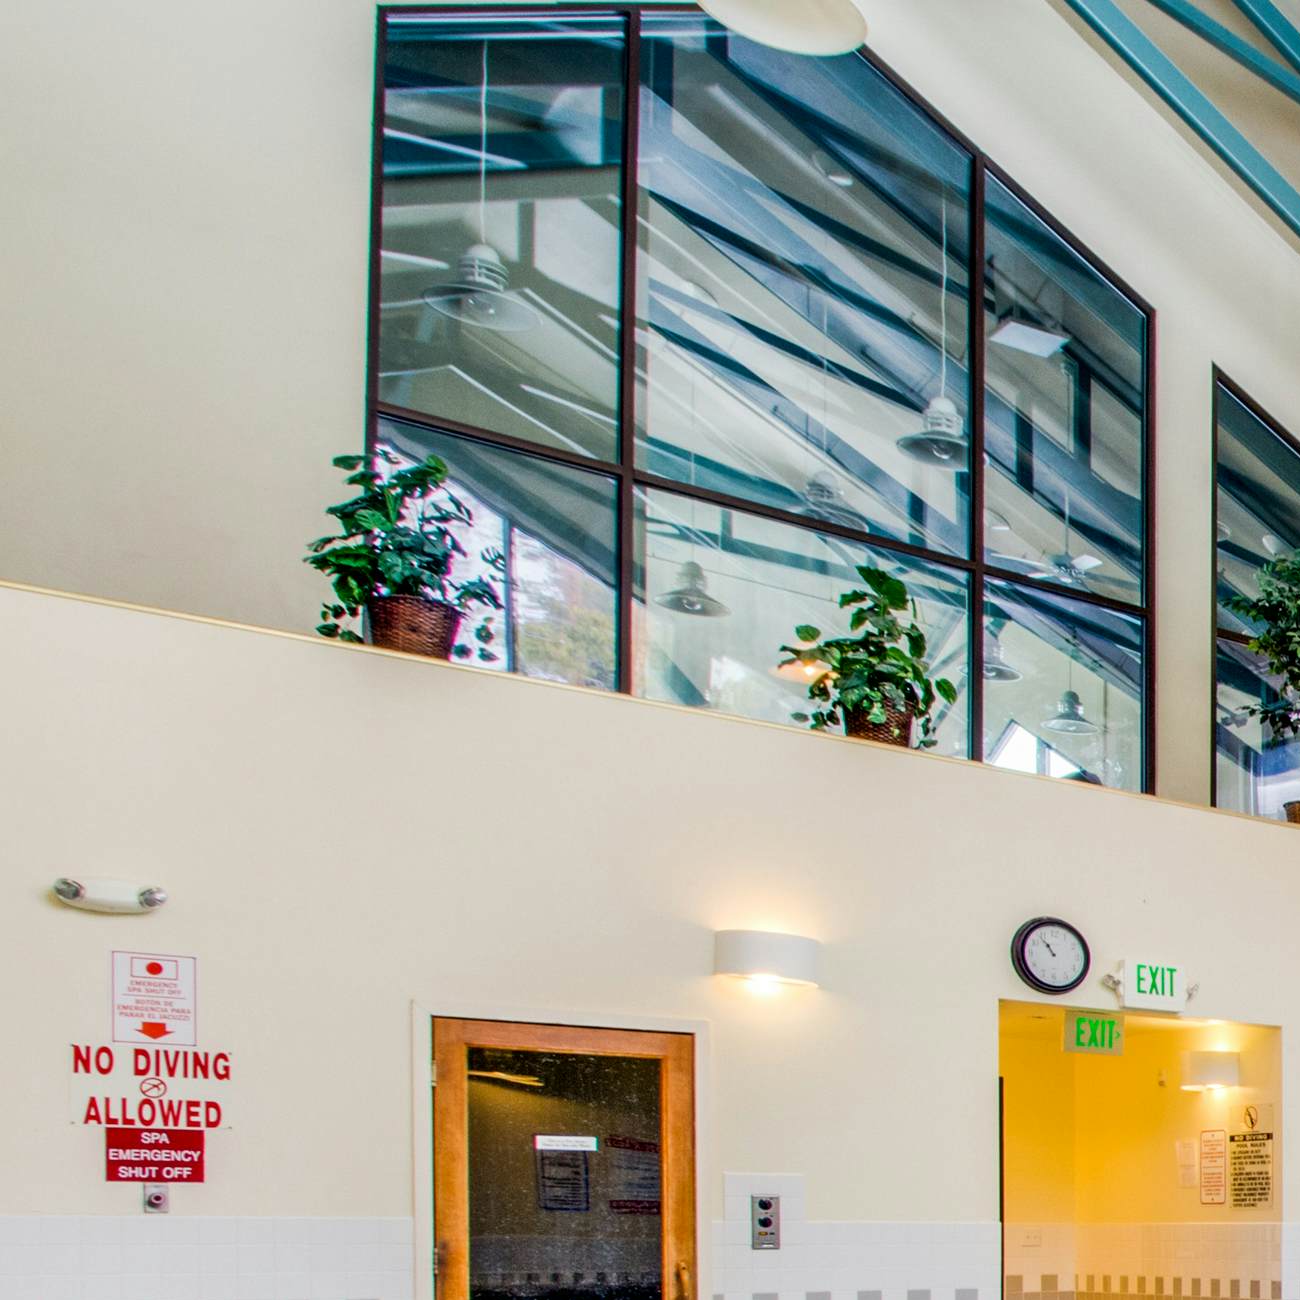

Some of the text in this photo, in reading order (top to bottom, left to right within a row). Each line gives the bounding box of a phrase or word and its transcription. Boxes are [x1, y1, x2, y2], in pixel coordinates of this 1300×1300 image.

[1136, 964, 1177, 997] EXIT
[1075, 1017, 1116, 1049] EXIT
[72, 1044, 231, 1081] NO DIVING
[83, 1096, 222, 1129] ALLOWED
[140, 1132, 170, 1144] SPA
[108, 1148, 201, 1162] EMERGENCY
[118, 1166, 193, 1179] SHUT OFF
